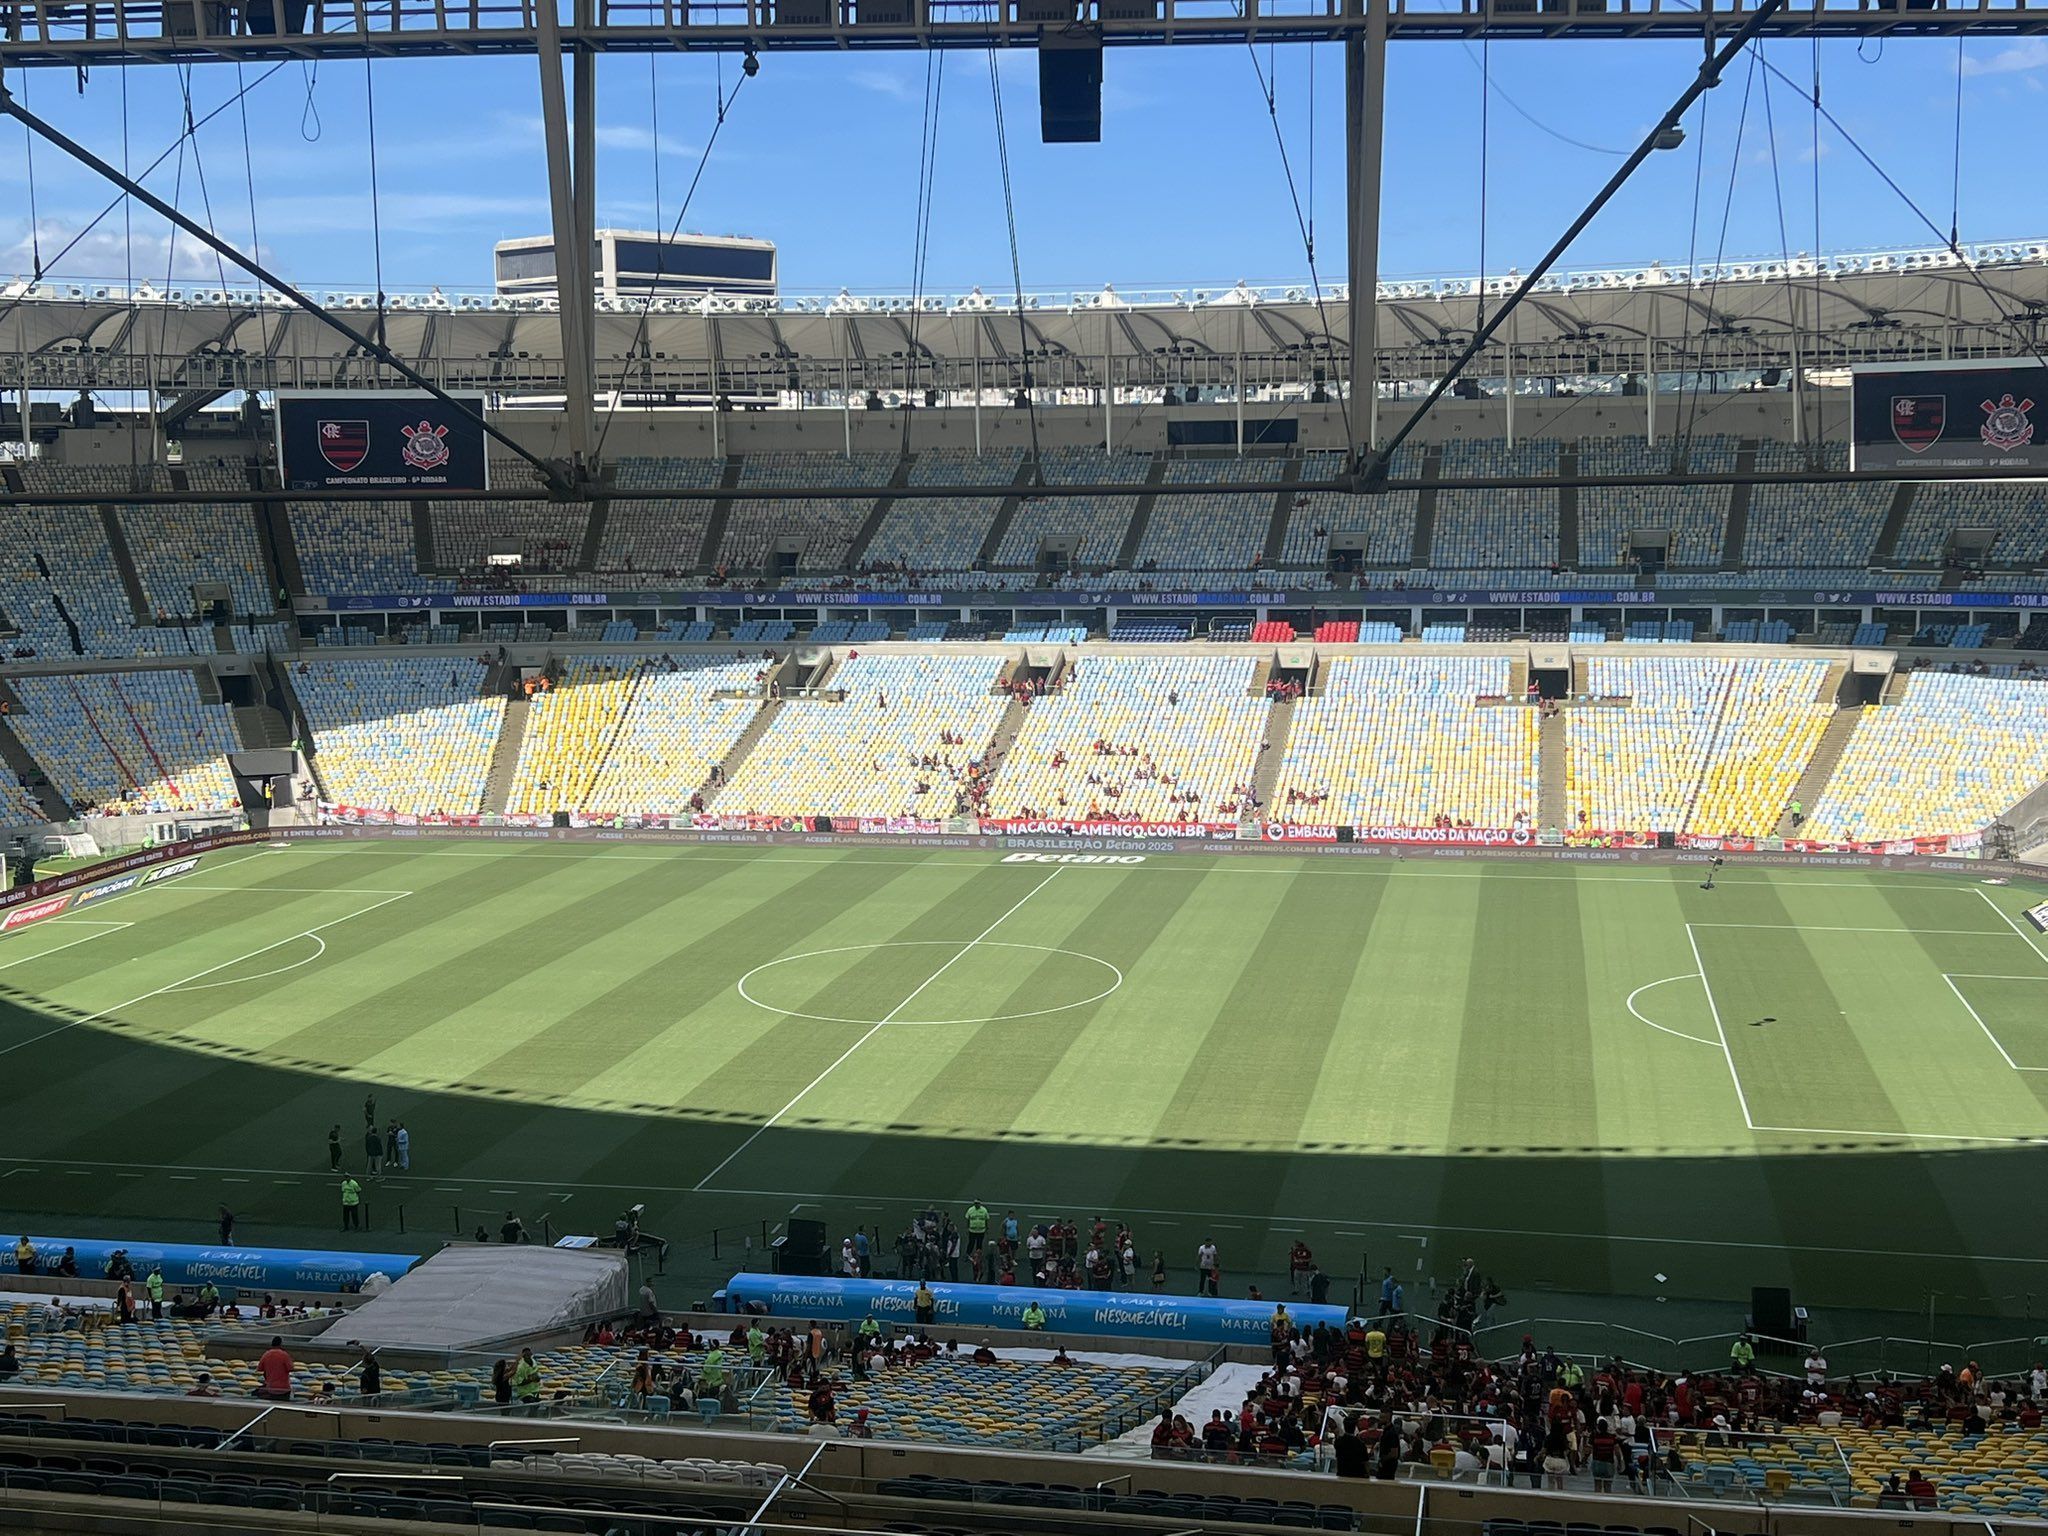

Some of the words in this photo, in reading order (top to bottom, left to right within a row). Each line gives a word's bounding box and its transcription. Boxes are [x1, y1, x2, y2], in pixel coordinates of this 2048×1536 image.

[1999, 458, 2029, 466] RODADA
[326, 477, 368, 485] CAMPEONATO
[421, 476, 447, 484] RODADA
[193, 840, 212, 850] ACESSE
[316, 828, 343, 836] GRÁTIS
[524, 830, 549, 838] GRÁTIS
[731, 834, 757, 842] GRÁTIS
[1288, 826, 1359, 839] EMBAIXAS
[1371, 828, 1446, 841] CONSULADOS
[1449, 829, 1465, 842] DA
[1468, 829, 1508, 845] NAÇÃO
[943, 838, 969, 846] GRÁTIS
[1007, 838, 1103, 850] BRASILEIRÃO
[1106, 839, 1146, 850] Betano
[1148, 842, 1174, 851] 2025
[1352, 847, 1380, 855] GRÁTIS
[1433, 849, 1464, 857] ACESSE
[1590, 852, 1620, 860] GRÁTIS
[1000, 853, 1146, 864] Betano
[1709, 855, 1799, 864] APREMIOS.COM.BR
[1810, 857, 1838, 865] ENTRE
[1839, 857, 1871, 866] GRÁTIS
[1930, 861, 1965, 869] ACESSE
[186, 1262, 267, 1282] INESQUECÍVEL!
[772, 1293, 844, 1306] MARACANÃ
[1121, 1298, 1153, 1306] CASA
[1094, 1307, 1187, 1330] INESQUECÍVEL!
